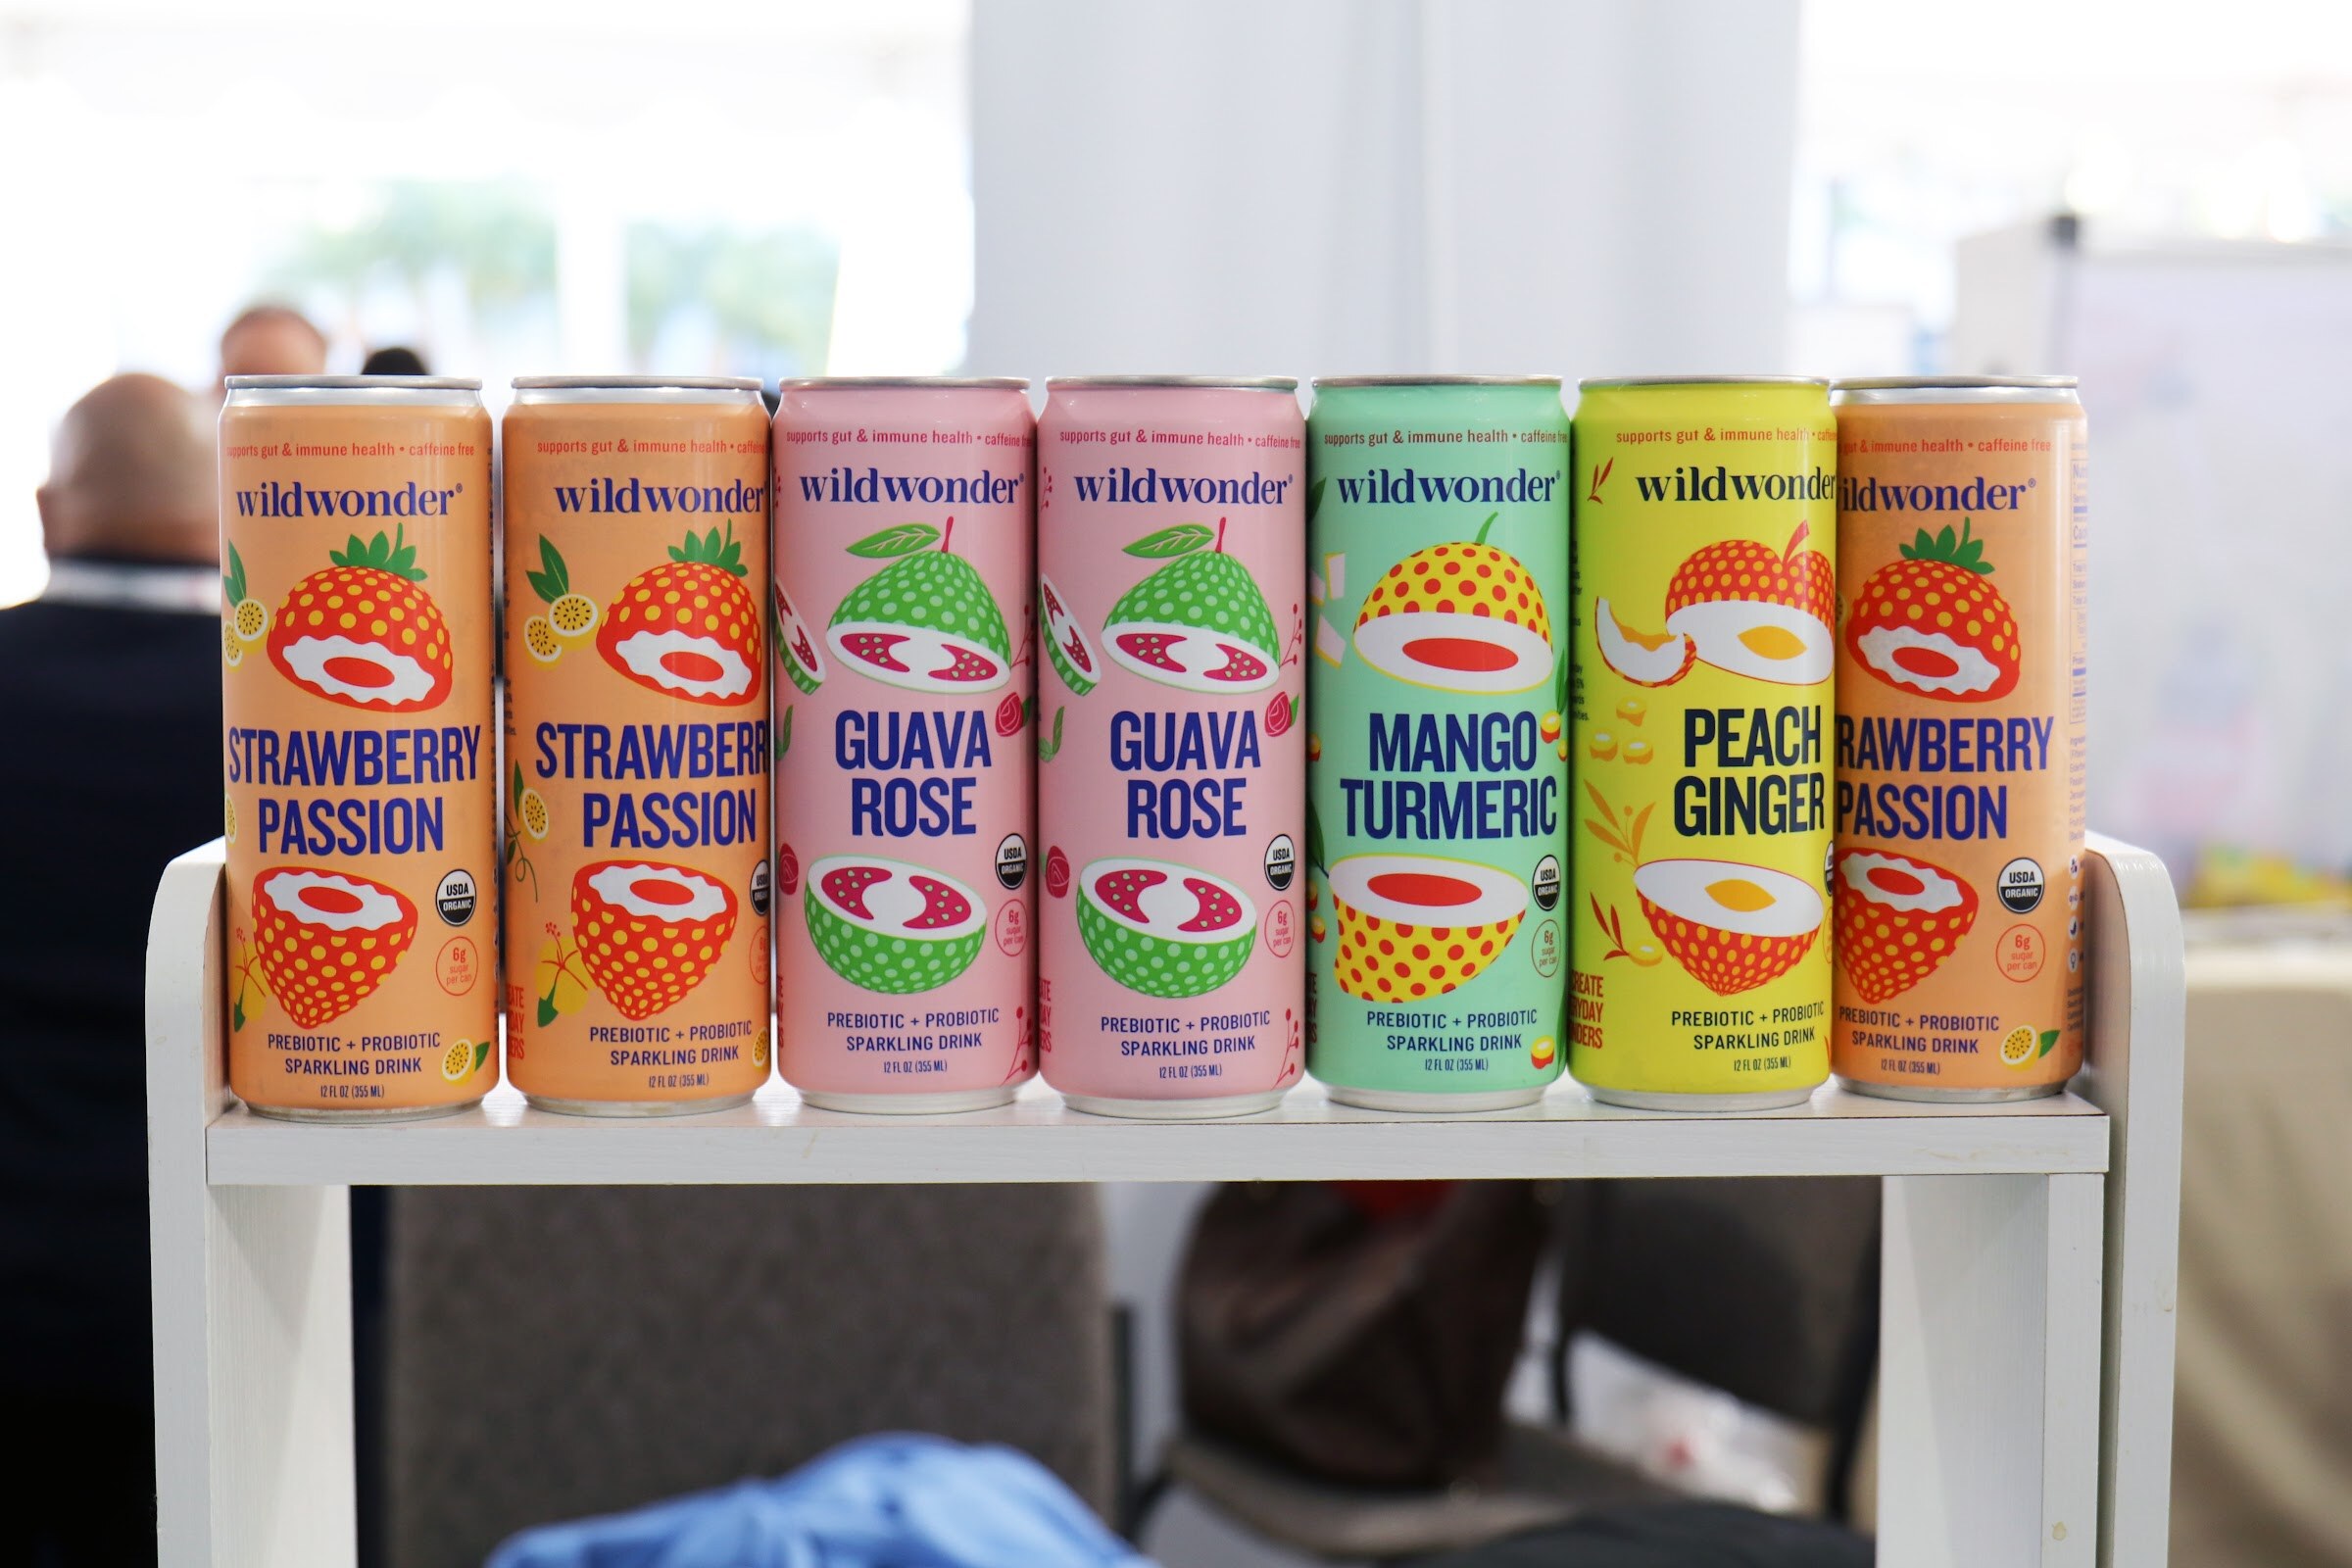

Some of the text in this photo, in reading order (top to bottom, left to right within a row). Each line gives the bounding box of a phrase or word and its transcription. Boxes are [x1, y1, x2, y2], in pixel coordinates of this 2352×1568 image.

[787, 430, 828, 445] supports
[832, 431, 853, 445] gut
[857, 429, 868, 443] &
[872, 430, 927, 443] immune
[933, 431, 972, 444] health
[985, 433, 1020, 447] caffeine
[1060, 431, 1105, 445] supports
[1110, 430, 1131, 445] gut
[1136, 429, 1147, 443] &
[1152, 431, 1203, 445] immune
[1207, 431, 1245, 447] health
[1255, 435, 1290, 449] caffeine
[1325, 433, 1364, 447] supports
[1368, 433, 1388, 447] gut
[1392, 430, 1403, 443] &
[1408, 431, 1462, 443] immune
[1468, 429, 1508, 443] health
[1521, 429, 1556, 443] caffeine
[1617, 430, 1672, 445] supports
[1677, 429, 1698, 445] gut
[1703, 427, 1715, 441] &
[1721, 427, 1772, 441] immune
[1776, 427, 1809, 441] health
[261, 445, 278, 460] gut
[282, 443, 292, 457] &
[296, 443, 347, 457] immune
[352, 443, 395, 457] health
[410, 443, 455, 457] caffeine
[459, 443, 474, 456] free
[538, 440, 587, 456] supports
[592, 441, 612, 456] gut
[617, 439, 629, 453] &
[633, 440, 686, 453] immune
[691, 440, 727, 453] health
[1860, 439, 1868, 453] &
[1872, 440, 1917, 453] immune
[1922, 439, 1964, 452] health
[1978, 439, 2028, 452] caffeine
[2032, 439, 2051, 451] free
[1636, 466, 1836, 502] wildwonder
[1841, 476, 2036, 512] ildwonder®
[835, 710, 992, 770] GUAVA
[1110, 710, 1261, 772] GUAVA
[1369, 710, 1537, 772] MANGO
[1684, 706, 1821, 768] PEACH
[1836, 715, 2054, 772] RAWBERRY
[229, 725, 480, 786] STRAWBERRY
[535, 719, 769, 780] STRAWBERR
[852, 776, 976, 837] ROSE
[1127, 777, 1247, 840] ROSE
[1340, 775, 1556, 840] TURMERIC
[1674, 772, 1825, 837] GINGER
[1838, 780, 2007, 841] PASSION
[259, 797, 443, 857] PASSION
[583, 788, 756, 849] PASSION
[1004, 847, 1021, 860] USDA
[1272, 847, 1290, 860] USDA
[1270, 864, 1292, 876] ORGANIC
[1541, 868, 1556, 882] USDA
[2009, 871, 2035, 884] USDA
[446, 882, 468, 896] USDA
[1537, 884, 1558, 896] ORGANIC
[2005, 888, 2038, 899] ORGANIC
[443, 900, 472, 911] ORGANIC
[1008, 909, 1019, 925] 6g
[1278, 910, 1288, 926] 6g
[1544, 930, 1553, 945] 6g
[2015, 934, 2031, 951] 6g
[453, 947, 466, 962] 6g
[2011, 951, 2034, 960] sugar
[2007, 960, 2037, 972] per can
[827, 1007, 1000, 1029] PREBIOTIC PROBIOTIC
[1102, 1010, 1270, 1033] PREBIOTIC PROBIOTIC
[1367, 1009, 1537, 1029] PREBIOTIC PROBIOTIC
[1672, 1002, 1825, 1027] PREBIOTIC PROBIOTIC
[1839, 1005, 1999, 1031] PREBIOTIC PROBIOTIC
[590, 1019, 753, 1043] PREBIOTIC PROBIOTIC
[1693, 1027, 1815, 1051] SPARKLING DRINK
[269, 1033, 441, 1053] PREBIOTIC PROBIOTIC
[847, 1033, 982, 1051] SPARKLING DRINK
[1121, 1035, 1255, 1056] SPARKLING DRINK
[1388, 1034, 1521, 1053] SPARKLING DRINK
[1852, 1031, 1979, 1054] SPARKLING DRINK
[611, 1045, 739, 1066] SPARKLING DRINK
[1734, 1056, 1791, 1071] 12 FL OZ (355 ML)
[285, 1057, 422, 1076] SPARKLING DRINK
[884, 1059, 948, 1073] 12 FL OZ (355 ML)
[1159, 1064, 1222, 1078] 12 FL OZ (355 ML)
[1425, 1058, 1489, 1072] 12 FL OZ (355 ML)
[1882, 1058, 1940, 1074] 12 FL OZ (355 ML)
[649, 1074, 710, 1088] 12 FL OZ (355 ML)
[320, 1084, 385, 1099] 12 FL OZ (355 ML)
